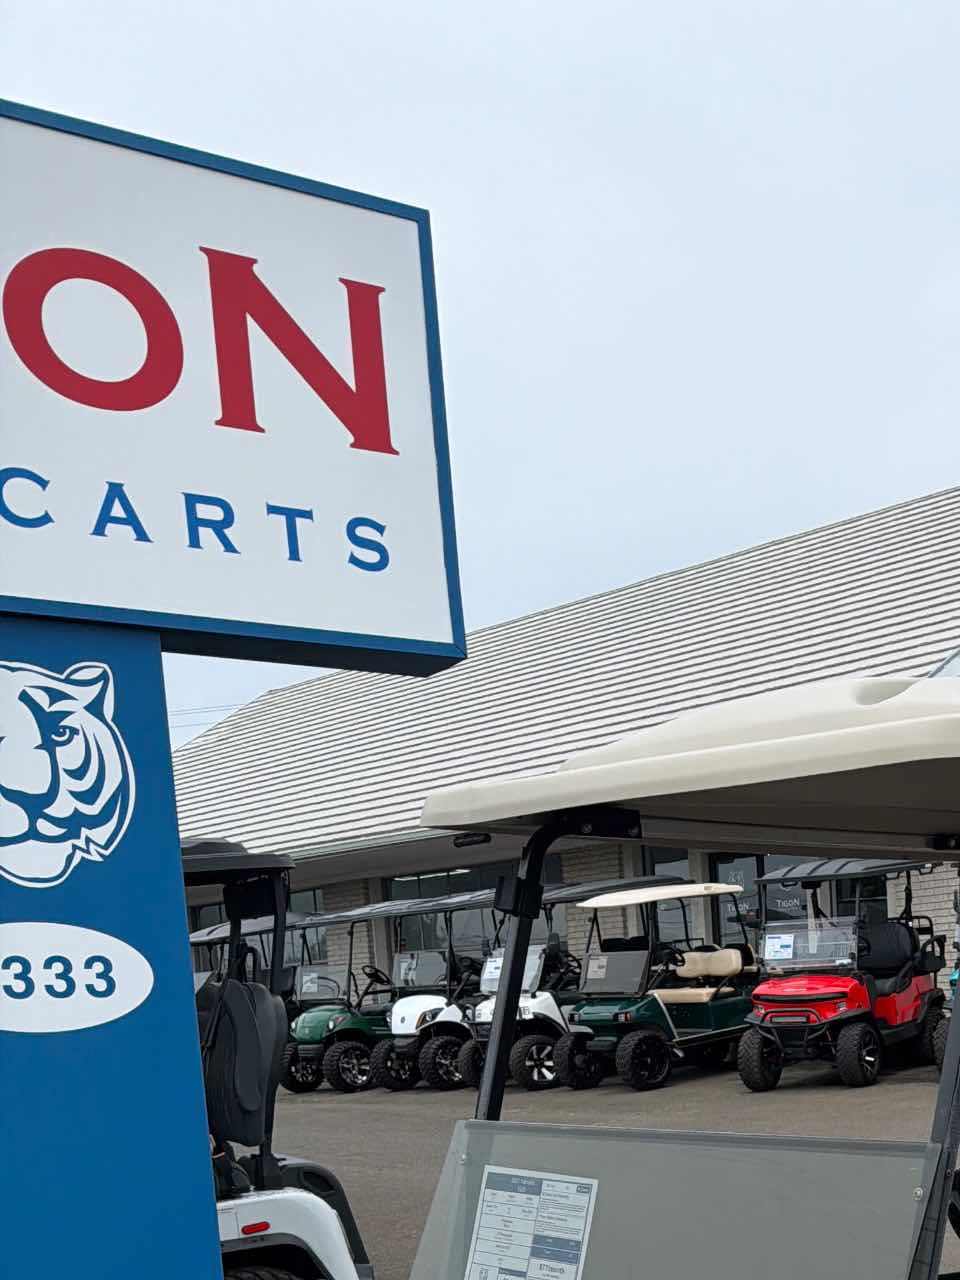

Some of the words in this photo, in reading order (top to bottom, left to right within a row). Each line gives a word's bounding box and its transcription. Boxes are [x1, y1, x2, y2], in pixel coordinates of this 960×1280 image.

[2, 245, 400, 456] ON
[0, 467, 391, 572] CARTS
[728, 902, 750, 912] TION
[776, 898, 800, 908] TIGON
[1, 955, 117, 1000] 333
